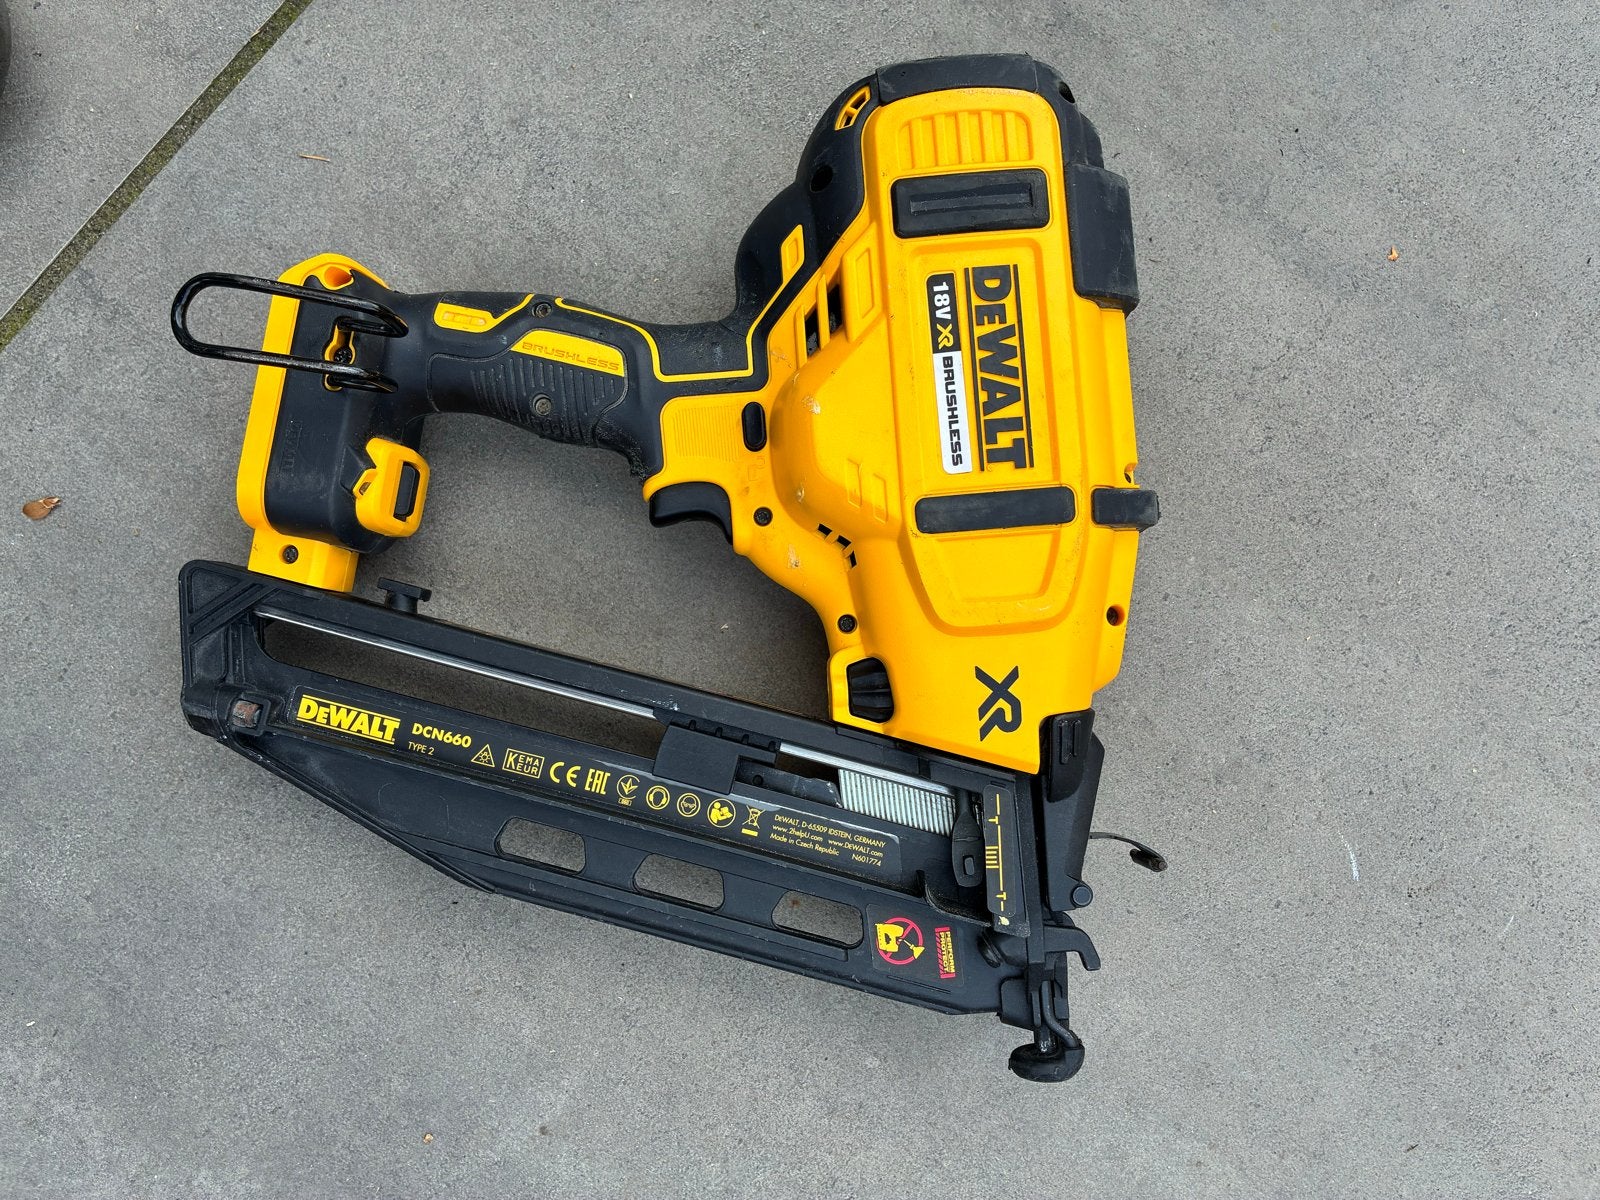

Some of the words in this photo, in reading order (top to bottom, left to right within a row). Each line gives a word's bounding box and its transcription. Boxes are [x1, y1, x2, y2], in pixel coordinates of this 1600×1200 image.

[933, 282, 951, 319] 18V
[937, 323, 954, 350] XR
[521, 341, 619, 371] BRUSHLESS
[942, 356, 963, 467] BRUSHLESS
[974, 665, 1022, 742] XR
[408, 741, 427, 755] TYPE
[427, 746, 435, 756] 2
[411, 722, 472, 749] DCN660
[549, 761, 582, 788] CE
[769, 833, 788, 843] Made
[795, 839, 814, 849] Czech
[814, 843, 840, 856] Republic
[772, 824, 824, 842] www.2helpU.com
[828, 839, 884, 858] www.DEWALT.com
[801, 821, 828, 833] D-65509
[828, 828, 853, 841] IDSTEIN,
[853, 834, 886, 848] GERMANY
[851, 854, 882, 867] N601774
[939, 932, 949, 973] PROTECT
[946, 931, 955, 972] PERFORM
